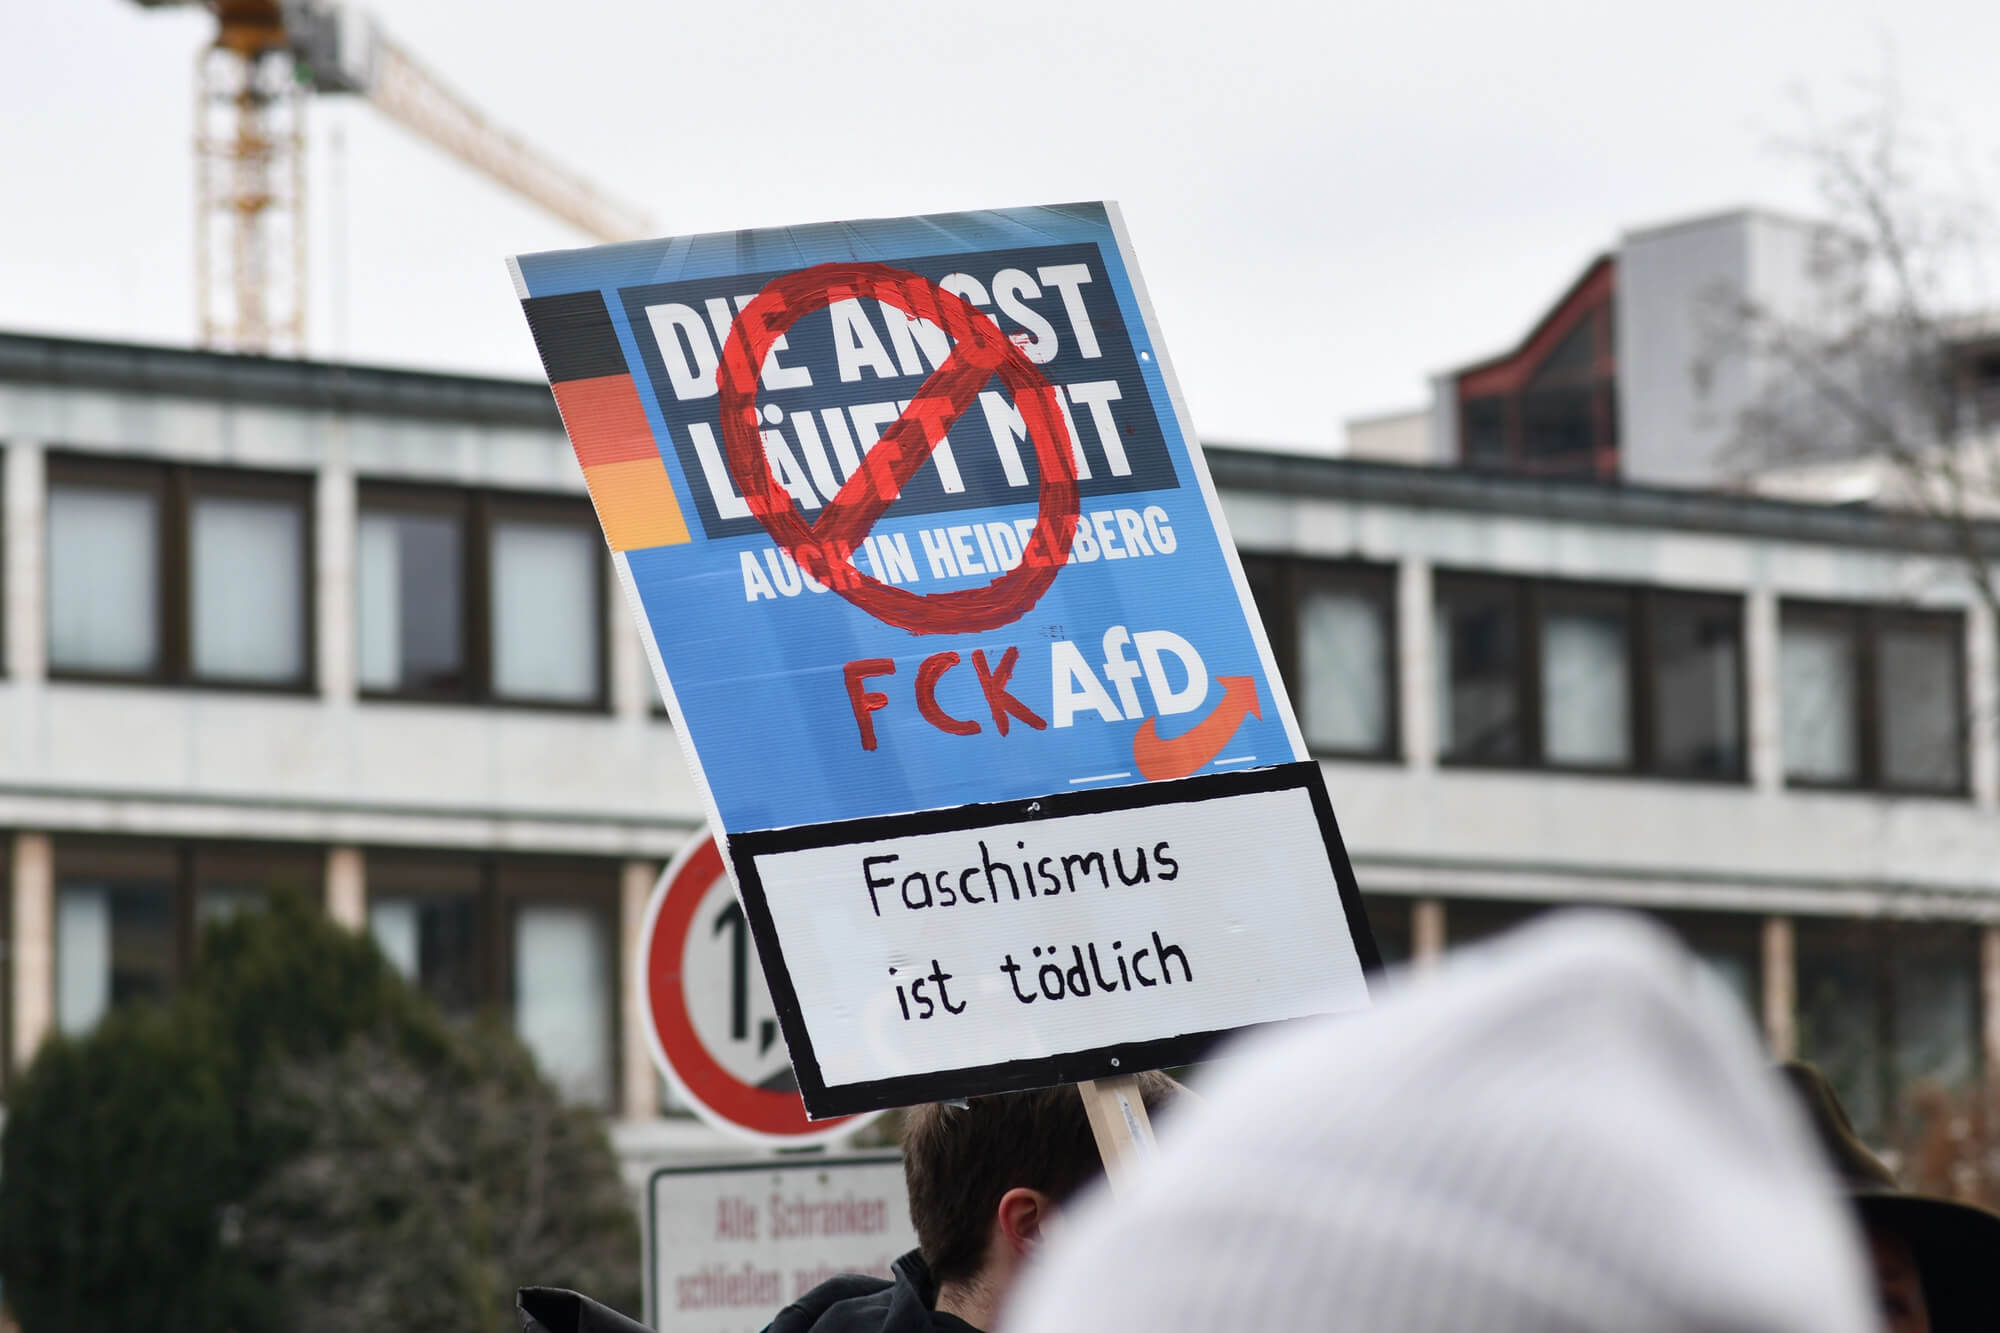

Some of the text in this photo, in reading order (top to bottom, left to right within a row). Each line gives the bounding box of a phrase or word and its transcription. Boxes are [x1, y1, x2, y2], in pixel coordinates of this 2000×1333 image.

[645, 263, 1102, 401] DIE ANGST
[688, 380, 1133, 520] LÄUFT MIT
[739, 505, 1178, 602] AUCH IN HEIDELBERG
[843, 645, 1047, 751] FCK
[1050, 625, 1209, 729] AfD
[862, 840, 1180, 917] Faschismus
[887, 931, 1193, 1020] ist tödlich
